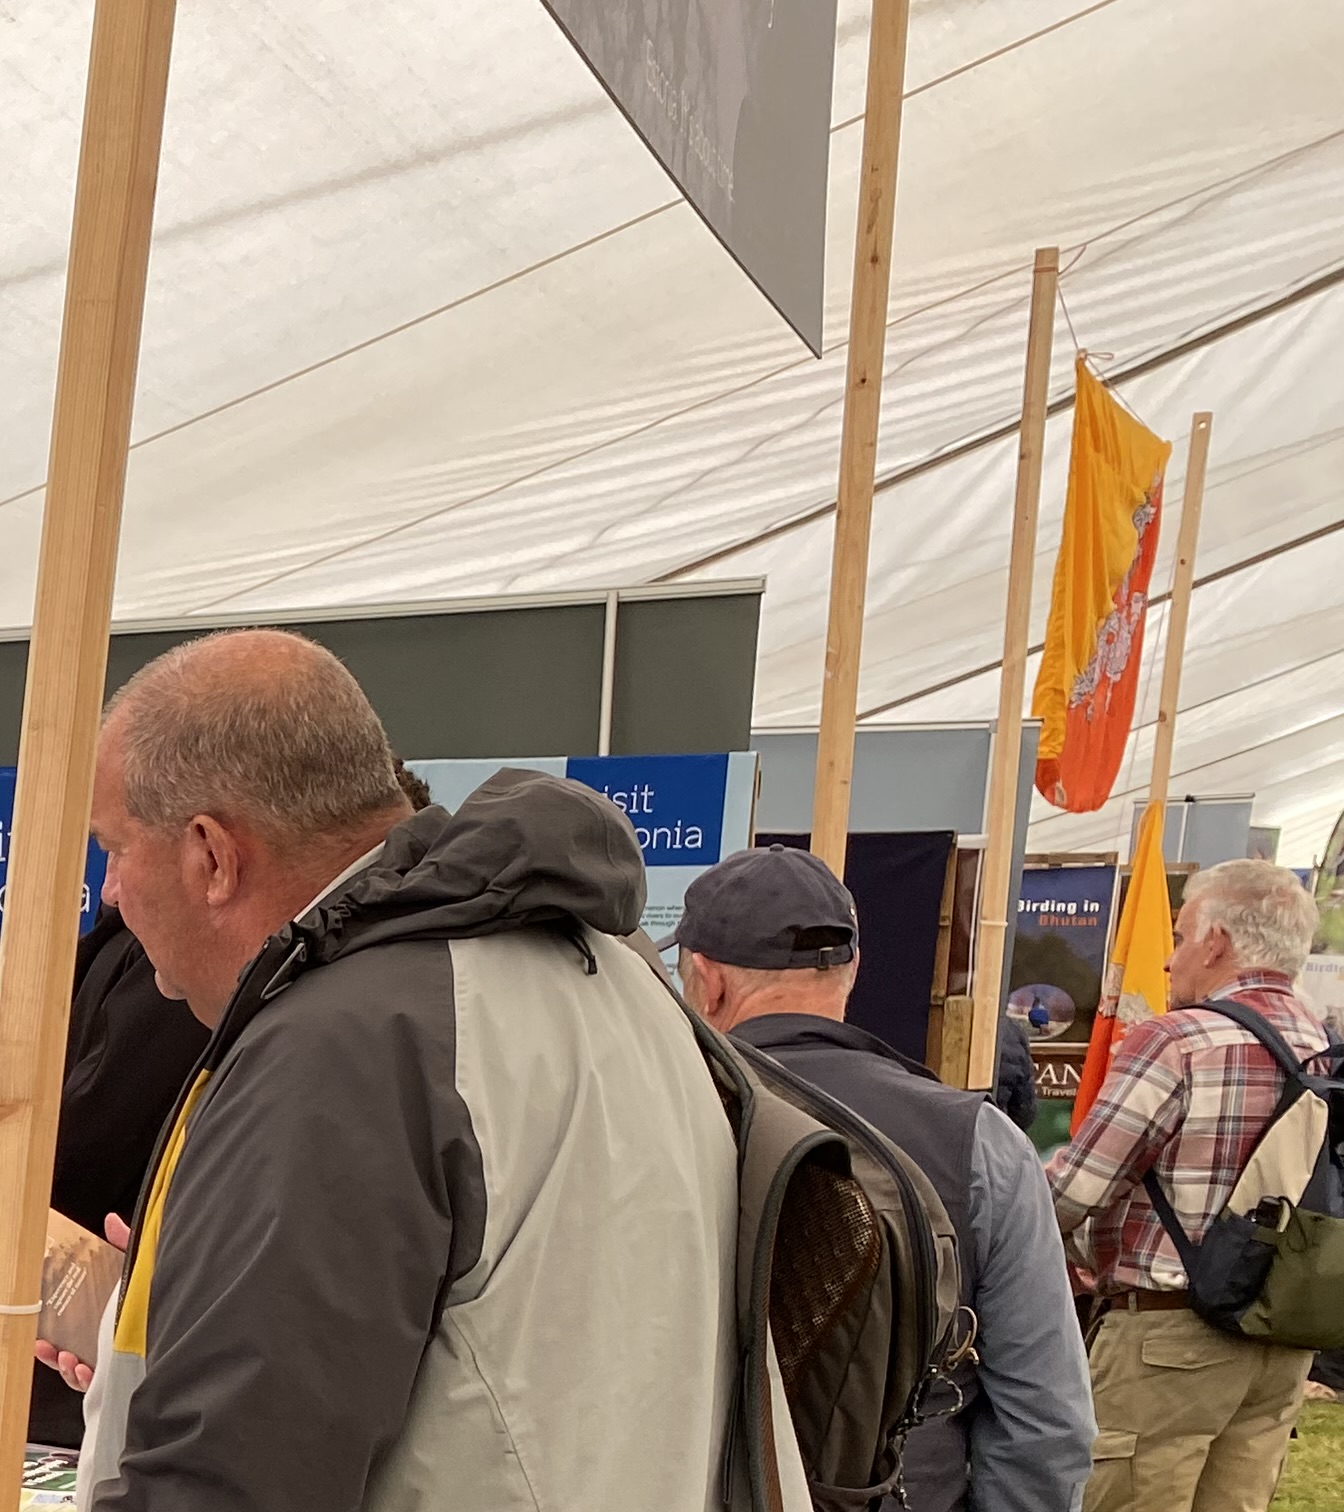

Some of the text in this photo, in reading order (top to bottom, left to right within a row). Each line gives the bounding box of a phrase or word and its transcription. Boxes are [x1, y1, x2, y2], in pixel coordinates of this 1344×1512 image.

[635, 819, 703, 849] onia
[1083, 899, 1100, 912] in
[1039, 914, 1098, 927] Bhutan
